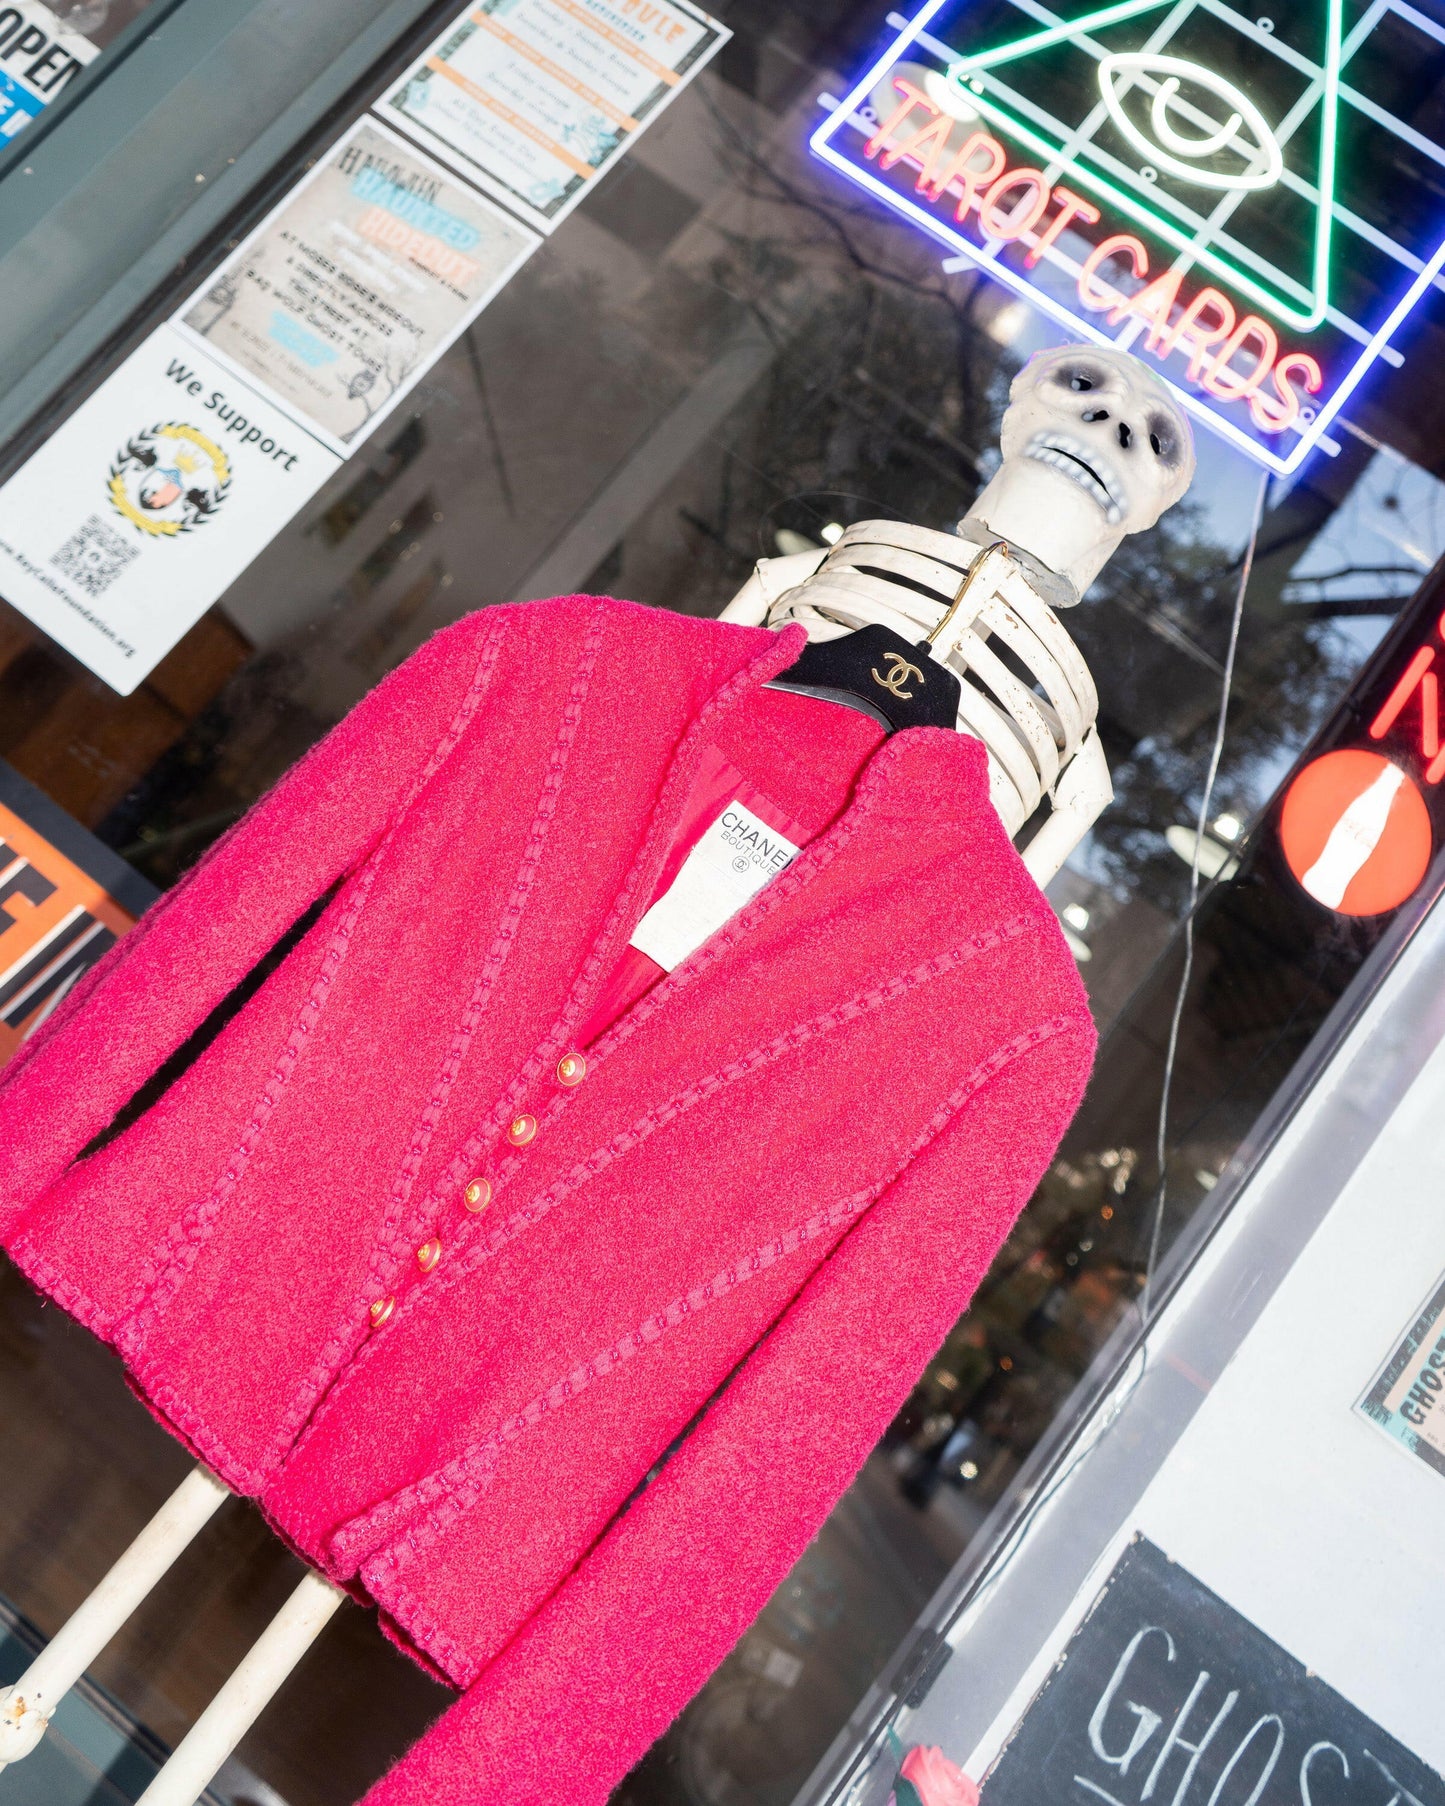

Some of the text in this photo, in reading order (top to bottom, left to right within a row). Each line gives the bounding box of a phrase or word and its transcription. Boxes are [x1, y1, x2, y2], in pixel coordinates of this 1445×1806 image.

[354, 204, 478, 285] HIDEOUT
[864, 78, 1323, 434] TAROT CARDS
[165, 357, 205, 395] We
[203, 391, 300, 472] Support
[720, 831, 776, 876] BOUTIQUE
